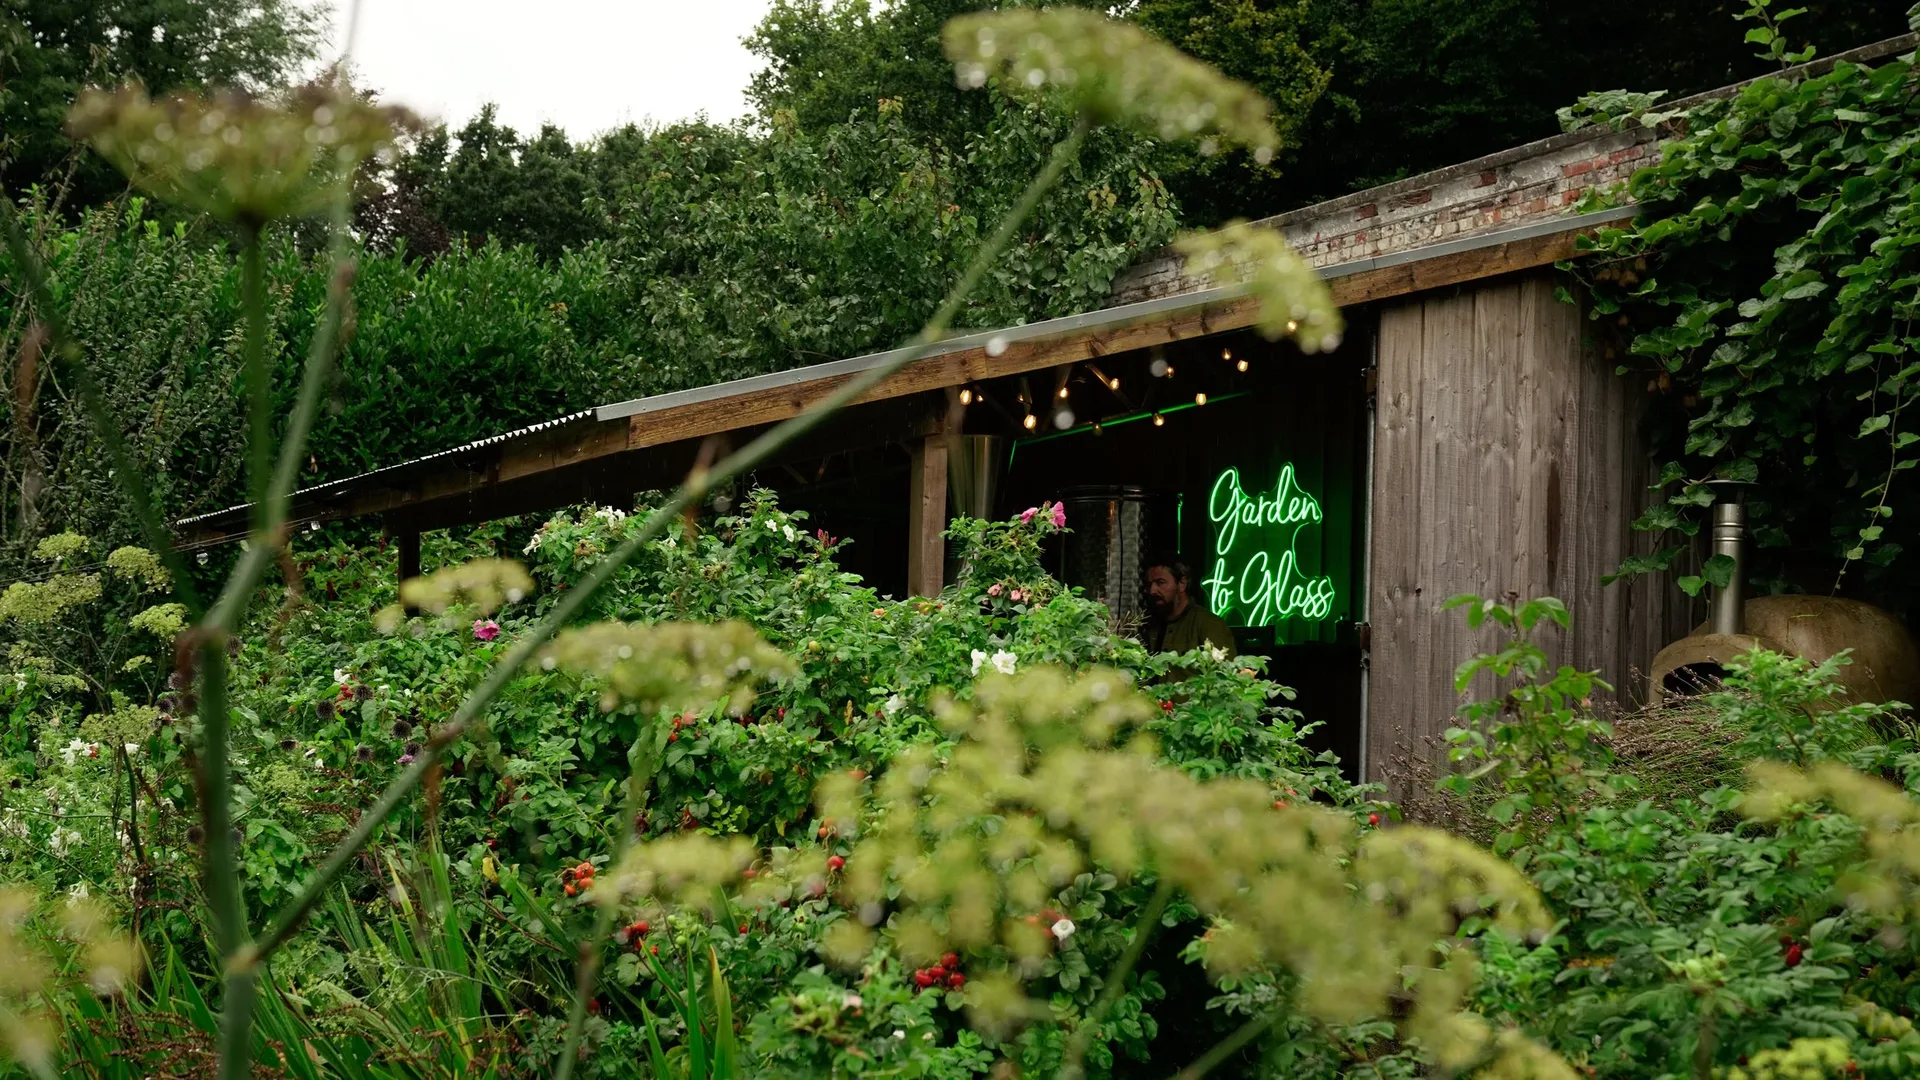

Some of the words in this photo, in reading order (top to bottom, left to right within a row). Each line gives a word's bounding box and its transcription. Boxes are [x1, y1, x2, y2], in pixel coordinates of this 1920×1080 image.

[1210, 465, 1320, 555] Garden
[1202, 558, 1234, 615] to
[1240, 550, 1333, 626] Glass
